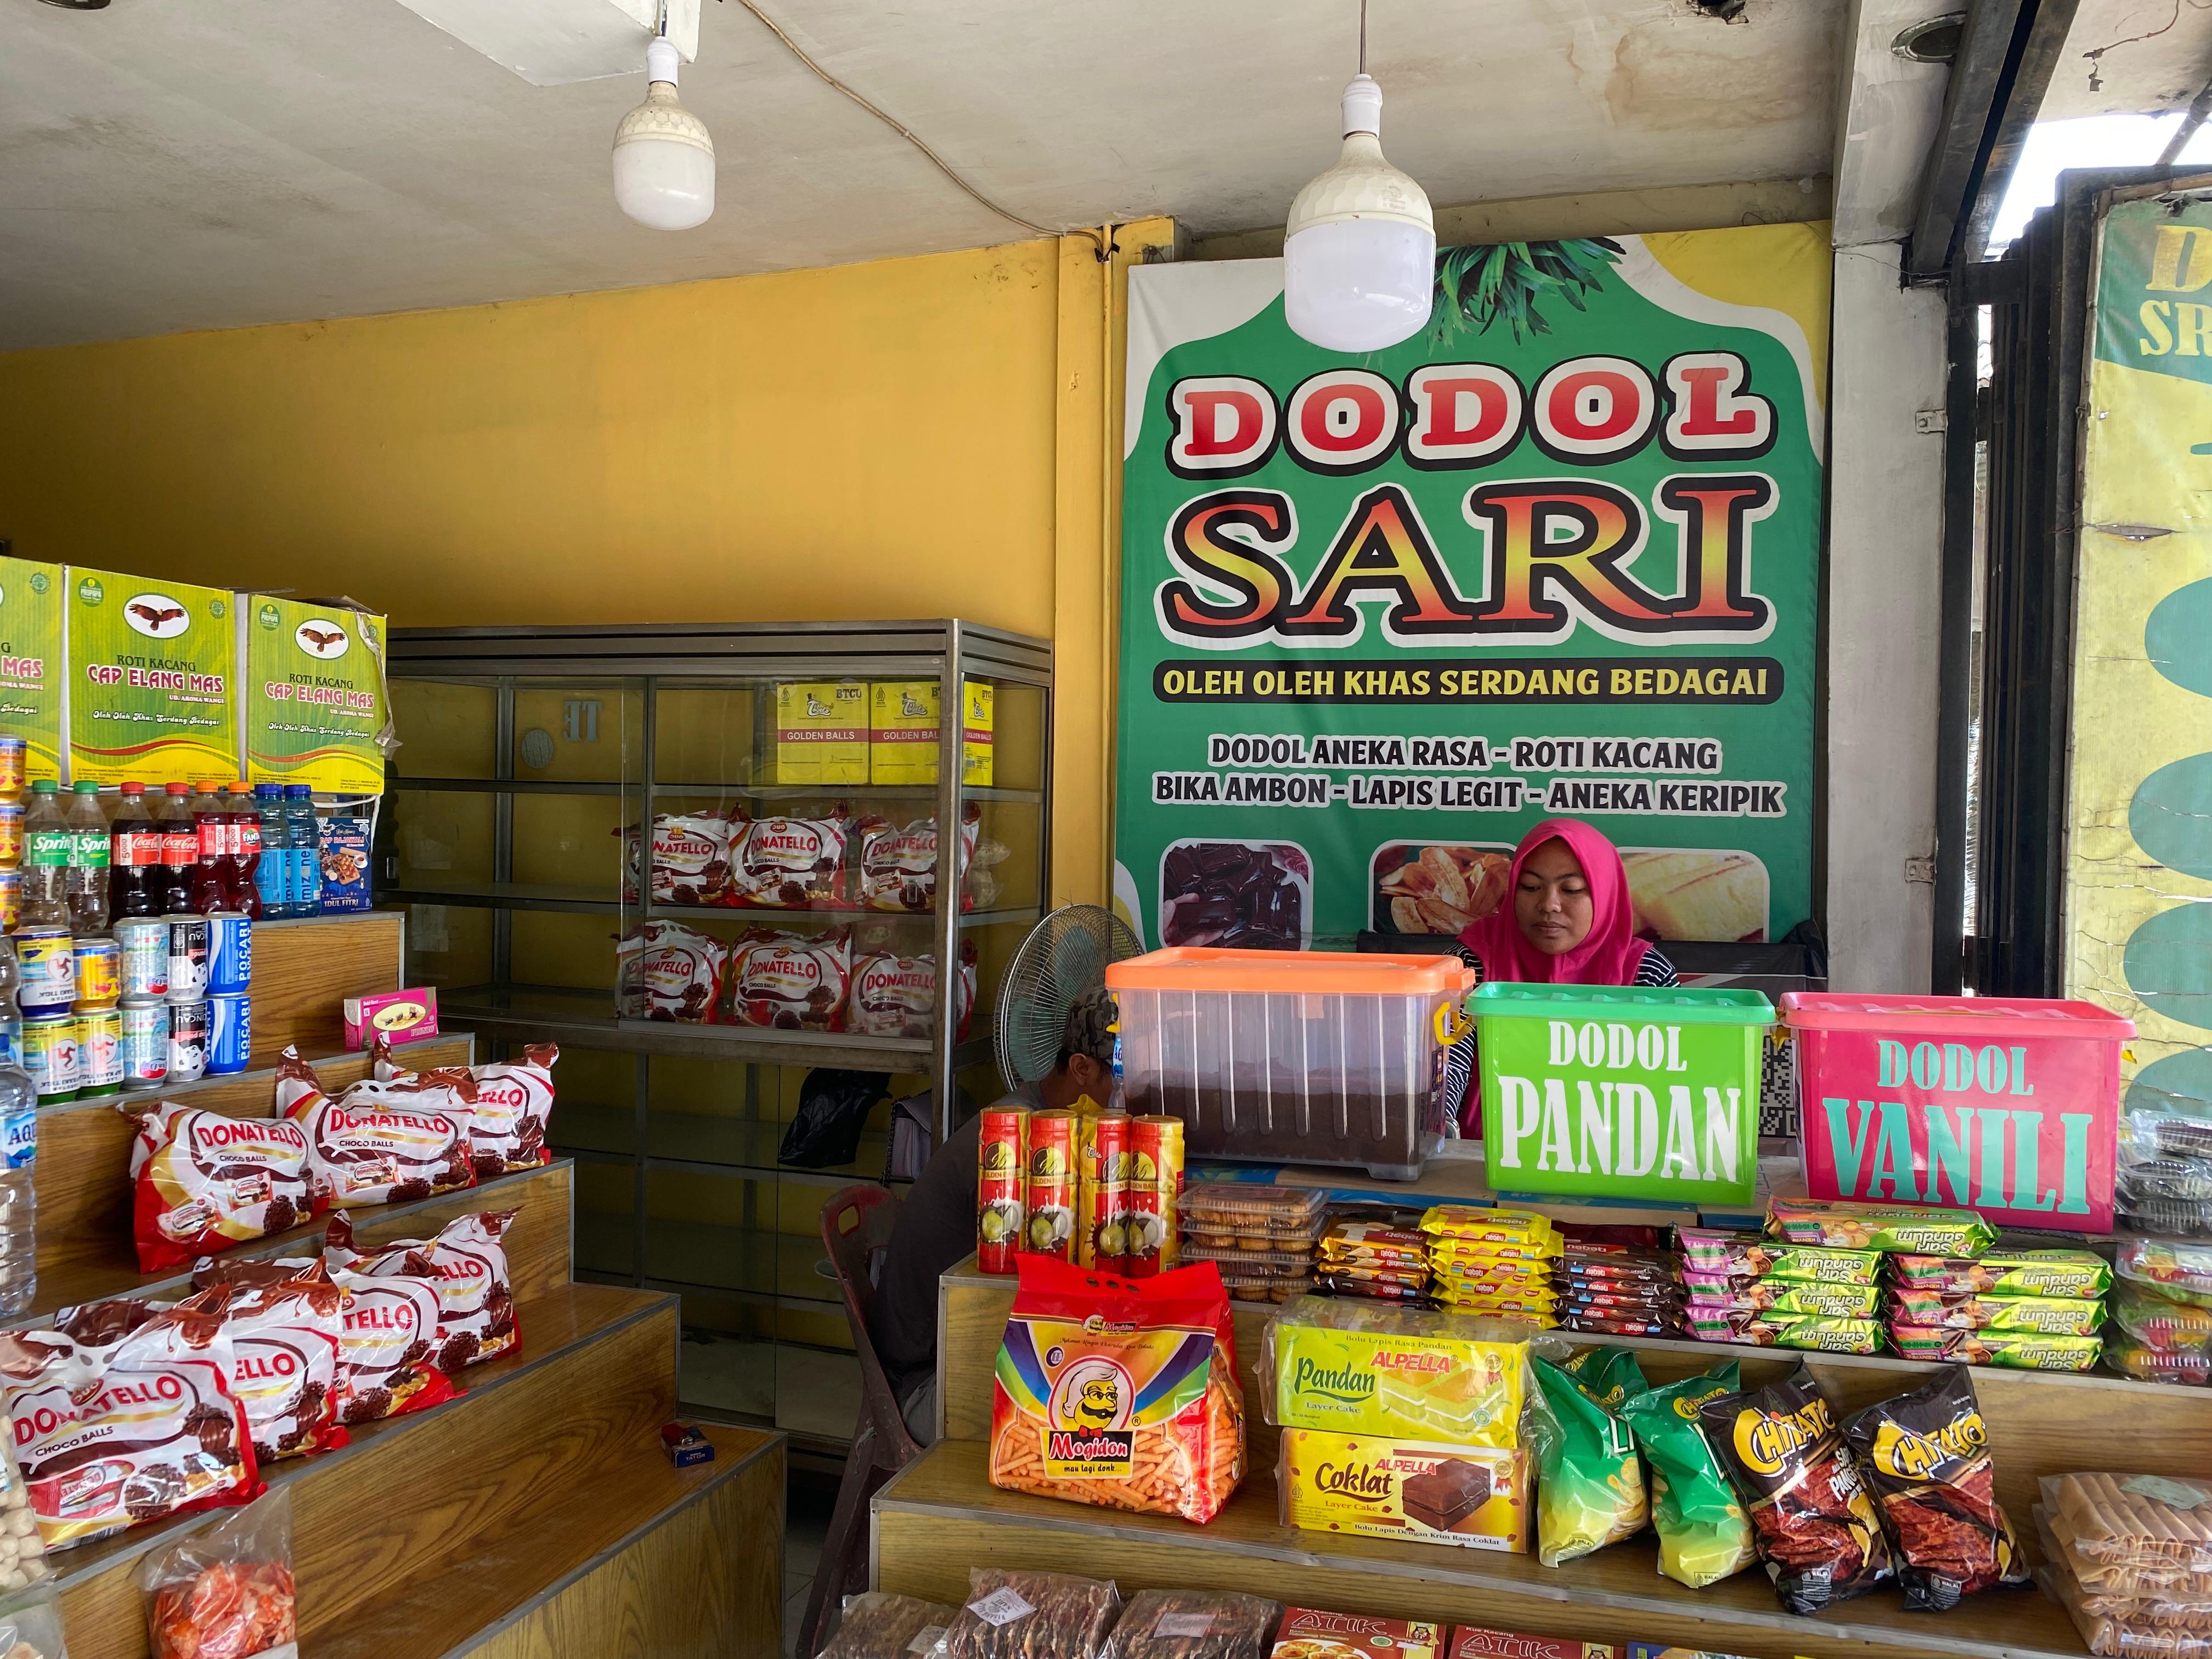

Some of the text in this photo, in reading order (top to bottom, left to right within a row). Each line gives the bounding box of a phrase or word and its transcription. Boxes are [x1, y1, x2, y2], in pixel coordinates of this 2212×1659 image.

[2146, 225, 2212, 292] D
[2140, 300, 2212, 357] SR
[1172, 357, 1771, 471] DODOL
[1158, 476, 1775, 642] SARI
[2, 656, 43, 678] MAS
[117, 655, 196, 672] ROTI KACANG
[87, 664, 224, 693] CAP ELANG MAS
[289, 674, 353, 690] ROTI KACANG
[1163, 668, 1768, 697] OLEH OLEH KHAS SERDANG BEDAGAI
[265, 681, 374, 709] CAP ELANG MAS
[787, 732, 823, 740] GOLDEN
[883, 732, 919, 740] GOLDEN
[1211, 738, 1718, 770] DODOL ANEKA RASA ROTI KACANG
[1155, 776, 1784, 814] BIKA AMBON LAPIS LEGIT ANEKA KERIPIK
[242, 832, 259, 842] FANT
[751, 836, 817, 853] DONATELLO
[78, 837, 110, 854] Sprit
[652, 842, 712, 856] NATELLO
[239, 922, 247, 981] POCARI
[748, 961, 816, 979] DONATELLO
[1549, 1020, 1688, 1072] DODOL
[1877, 1040, 2034, 1096] DODOL
[330, 1109, 449, 1135] DONATELLO
[1498, 1076, 1741, 1182] PANDAN
[8, 1123, 37, 1146] AQU
[197, 1123, 302, 1149] DONATELLO
[339, 1139, 370, 1148] CHOCO
[219, 1154, 267, 1163] CHOCO BALLS
[1822, 1097, 2094, 1214] VANILI
[1487, 1217, 1527, 1226] nabati
[1385, 1232, 1424, 1242] nabati
[1485, 1233, 1504, 1242] nabati
[1896, 1231, 1966, 1244] Gandum
[1380, 1250, 1398, 1258] nabati
[1916, 1242, 1954, 1254] Sari
[1464, 1268, 1483, 1276] nabati
[1497, 1263, 1515, 1272] nabati
[1798, 1258, 1865, 1271] Gandum
[1815, 1269, 1850, 1283] Sari
[2023, 1273, 2092, 1288] Gandum
[1383, 1286, 1401, 1295] nabati
[2041, 1285, 2079, 1297] Sari
[1801, 1294, 1866, 1307] Gandum
[1819, 1306, 1852, 1317] Sari
[2018, 1311, 2089, 1325] Gandum
[1625, 1323, 1645, 1332] nabati
[2039, 1322, 2074, 1334] Sari
[1346, 1335, 1452, 1350] Bolu Lapis Rasa Pandan
[1801, 1329, 1867, 1343] Gandum
[1819, 1341, 1854, 1352] Sari
[1369, 1351, 1451, 1374] ALPELLA
[2019, 1350, 2090, 1362] Gandum
[2039, 1360, 2076, 1371] Sari
[1294, 1357, 1376, 1394] Pandan
[14, 1375, 183, 1447] DONATELLO
[1306, 1401, 1361, 1414] Layer Cake
[35, 1426, 114, 1457] CHOCO BALLS
[1734, 1398, 1836, 1477] CHITATO
[1049, 1433, 1128, 1462] Mogidon
[1873, 1413, 1988, 1481] CHITATO
[1064, 1463, 1095, 1474] mau lagi
[1373, 1458, 1437, 1476] ALPELLA
[1314, 1462, 1393, 1494] Coklat
[1325, 1500, 1379, 1513] Layer Cake
[1354, 1523, 1500, 1546] Bolu Lapis Dengan Krim Rasa Coklat
[1291, 1613, 1387, 1635] ATIK
[1483, 1629, 1514, 1638] Kacang
[1462, 1634, 1562, 1659] ATIK
